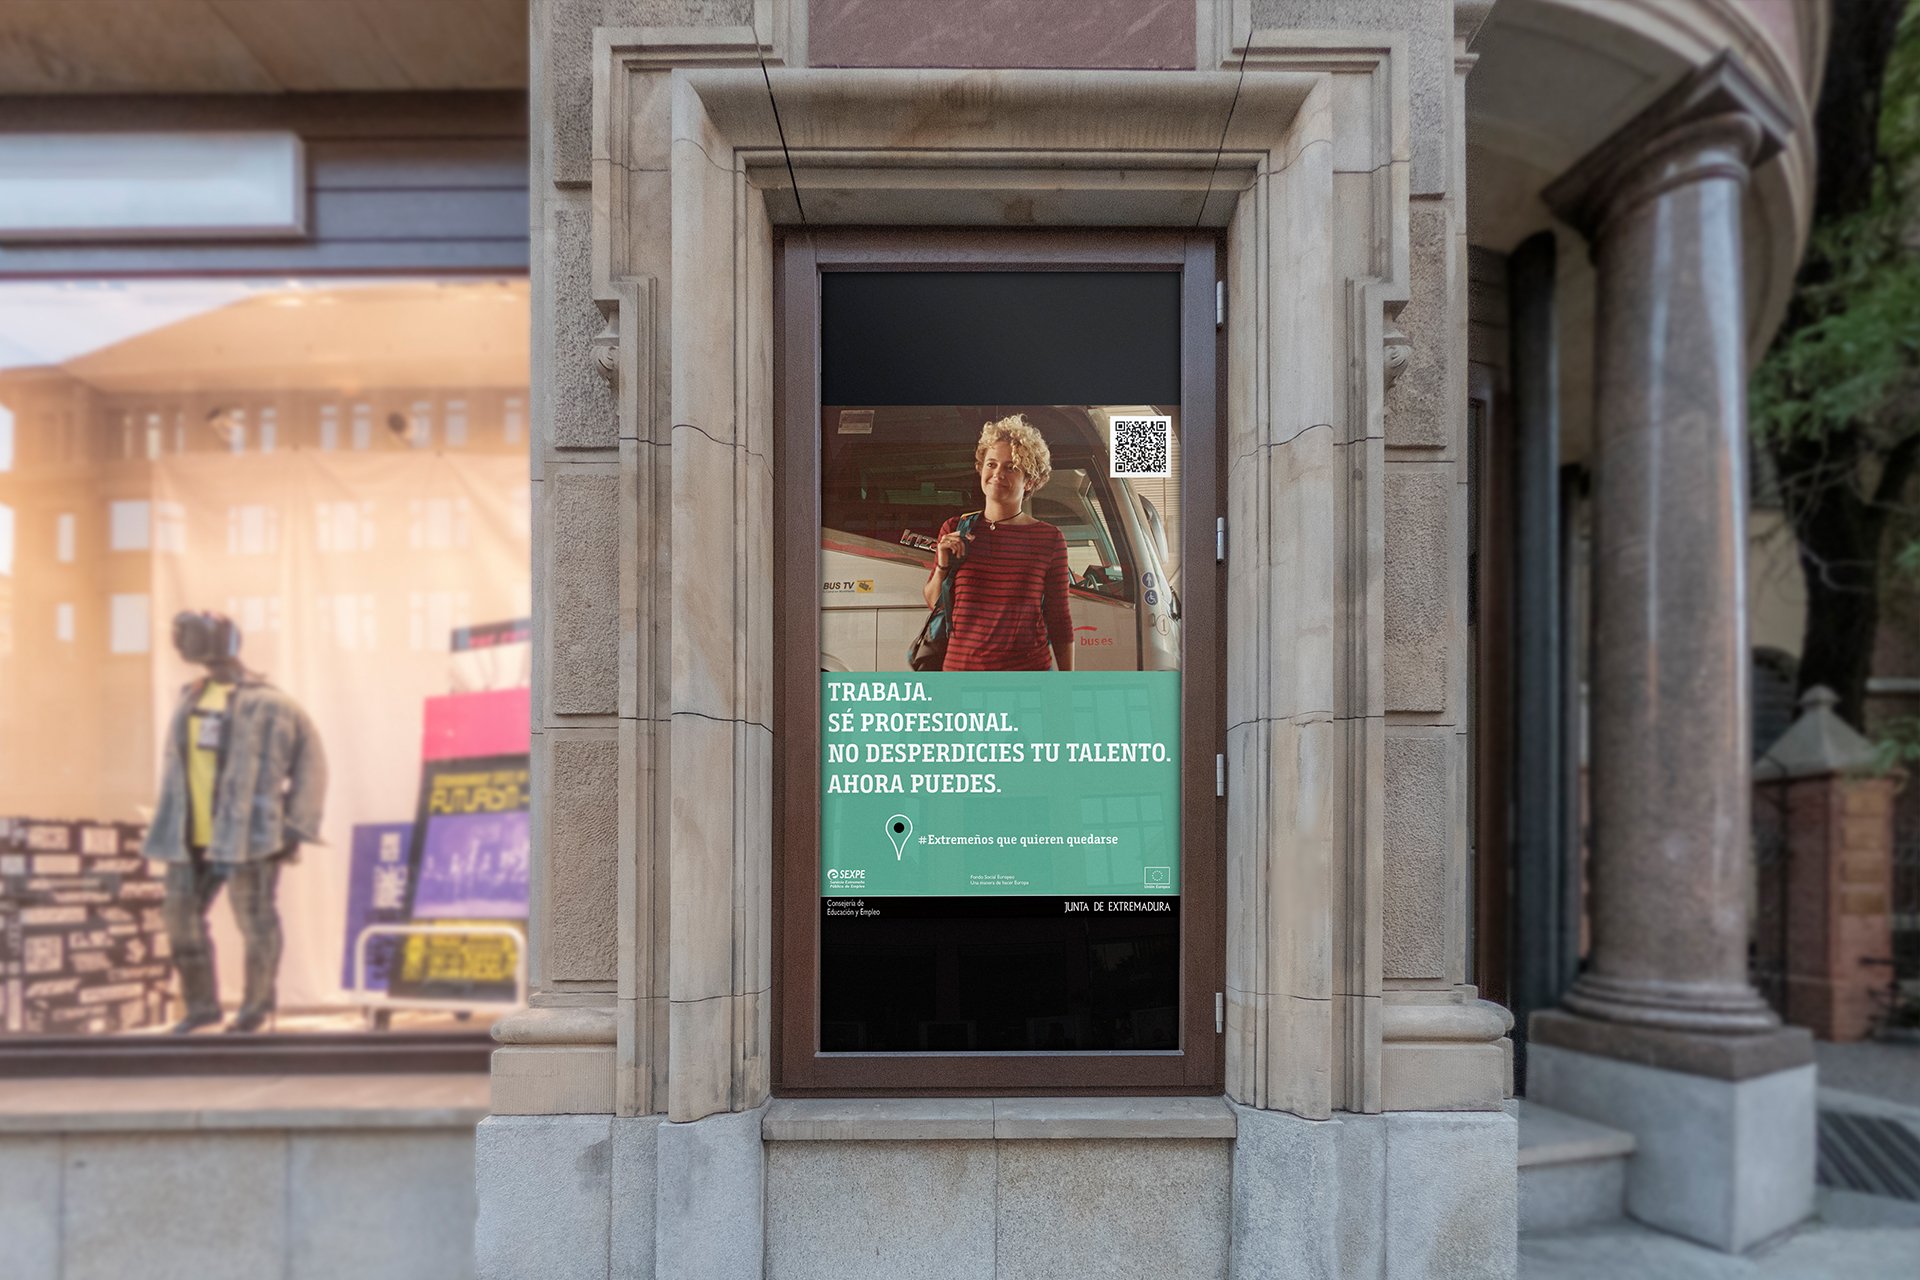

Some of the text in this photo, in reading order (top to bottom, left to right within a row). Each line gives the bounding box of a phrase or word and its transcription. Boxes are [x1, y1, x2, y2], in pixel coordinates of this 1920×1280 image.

[823, 582, 854, 590] BUS TV
[828, 682, 933, 702] TRABAJA.
[828, 708, 1019, 733] SÉ PROFESIONAL.
[828, 742, 1171, 763] NO DESPERDICIES TU TALENTO.
[827, 773, 1002, 794] AHORA PUEDES.
[918, 833, 1119, 848] #Extremeños que quieren quedarse
[840, 869, 866, 879] SEXPE
[827, 899, 864, 908] Consejería de
[1065, 901, 1171, 913] JUNTA DE EXTREMADURA
[827, 907, 854, 916] Educación
[860, 907, 881, 917] Empleo
